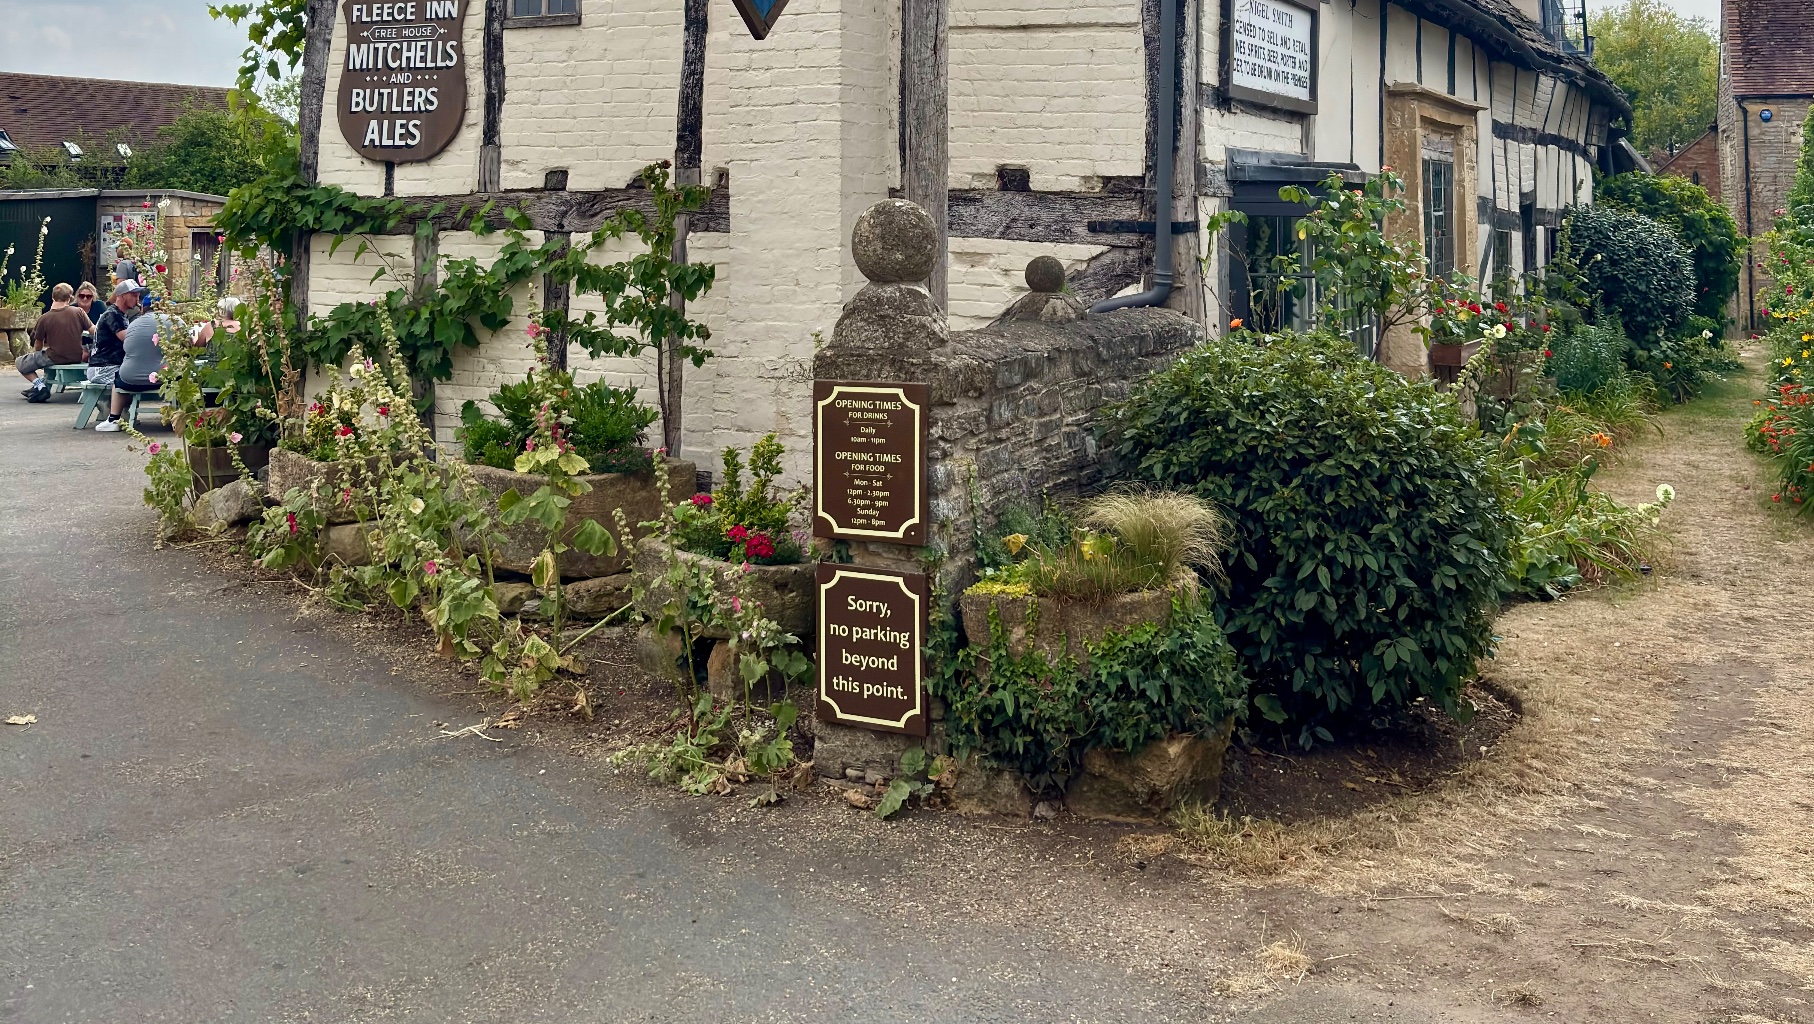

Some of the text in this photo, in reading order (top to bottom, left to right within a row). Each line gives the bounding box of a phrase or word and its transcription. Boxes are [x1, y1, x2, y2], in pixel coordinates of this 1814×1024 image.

[352, 0, 459, 23] FLEECE INN
[1272, 7, 1293, 29] SMITH
[374, 26, 432, 38] FREE HOUSE
[1235, 18, 1257, 39] CENSED
[1258, 26, 1266, 42] TO
[1266, 29, 1279, 47] SELL
[1280, 35, 1291, 51] AND
[348, 40, 458, 71] MITCHELLS
[1235, 38, 1246, 55] NES
[1298, 58, 1308, 73] AND
[389, 72, 412, 84] AND
[1243, 60, 1251, 75] TO
[1251, 62, 1257, 77] BE
[1273, 68, 1281, 83] ON
[1281, 70, 1290, 85] THE
[350, 86, 439, 113] BUTLERS
[363, 119, 422, 147] ALES
[835, 399, 902, 410] OPENING TIMES
[848, 411, 888, 420] FOR DRINKS
[860, 426, 876, 435] Daily
[870, 437, 886, 445] 11pm
[835, 451, 902, 463] OPENING TIMES
[851, 463, 885, 472] FOR FOOD
[853, 478, 868, 486] Mon
[872, 479, 883, 487] Sat
[847, 488, 863, 496] 12pm
[867, 490, 890, 498] 2.30pm
[847, 497, 871, 506] 6.30pm
[857, 507, 880, 517] Sunday
[851, 517, 867, 525] 12pm
[871, 518, 886, 527] 8pm
[847, 595, 892, 618] Sorry,
[829, 623, 910, 649] no parking
[842, 649, 898, 671] beyond
[832, 675, 908, 700] this point.
